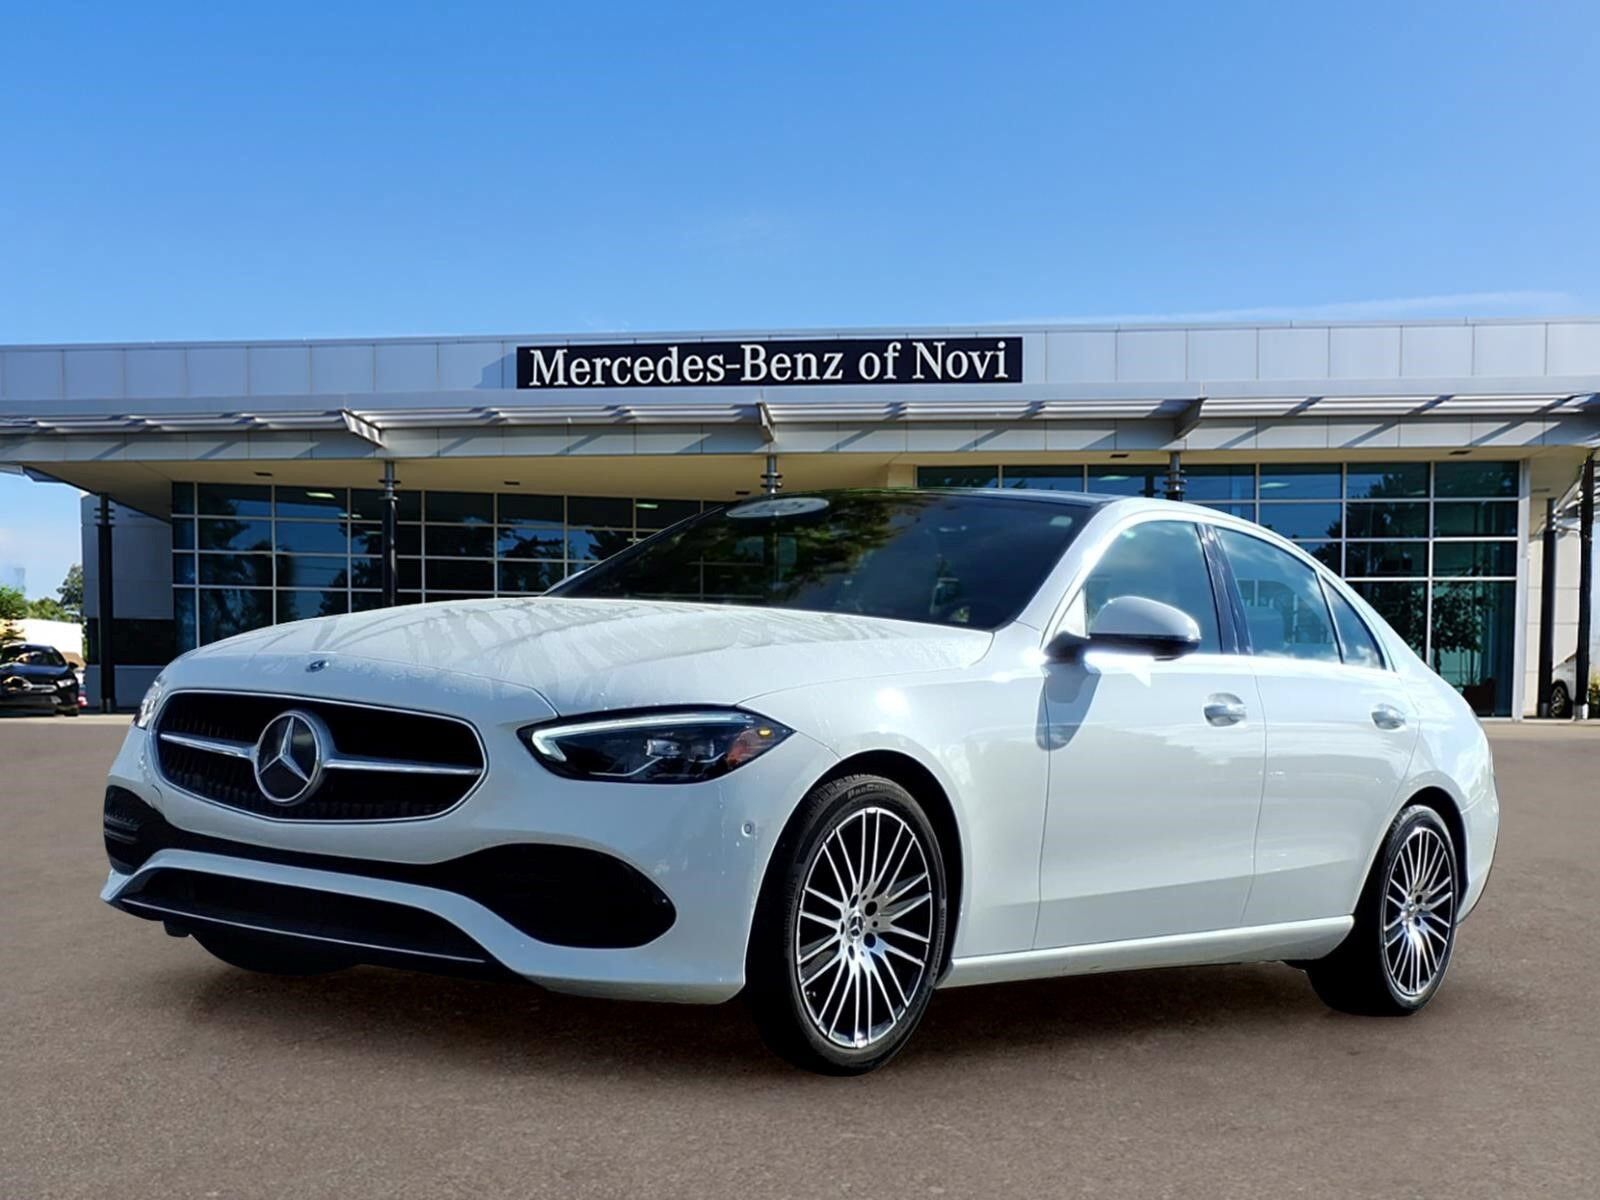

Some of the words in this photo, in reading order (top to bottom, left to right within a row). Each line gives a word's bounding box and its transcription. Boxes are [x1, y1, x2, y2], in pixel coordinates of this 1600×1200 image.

[529, 344, 844, 387] Mercedes-Benz
[858, 342, 901, 380] of
[912, 340, 1009, 380] Novi
